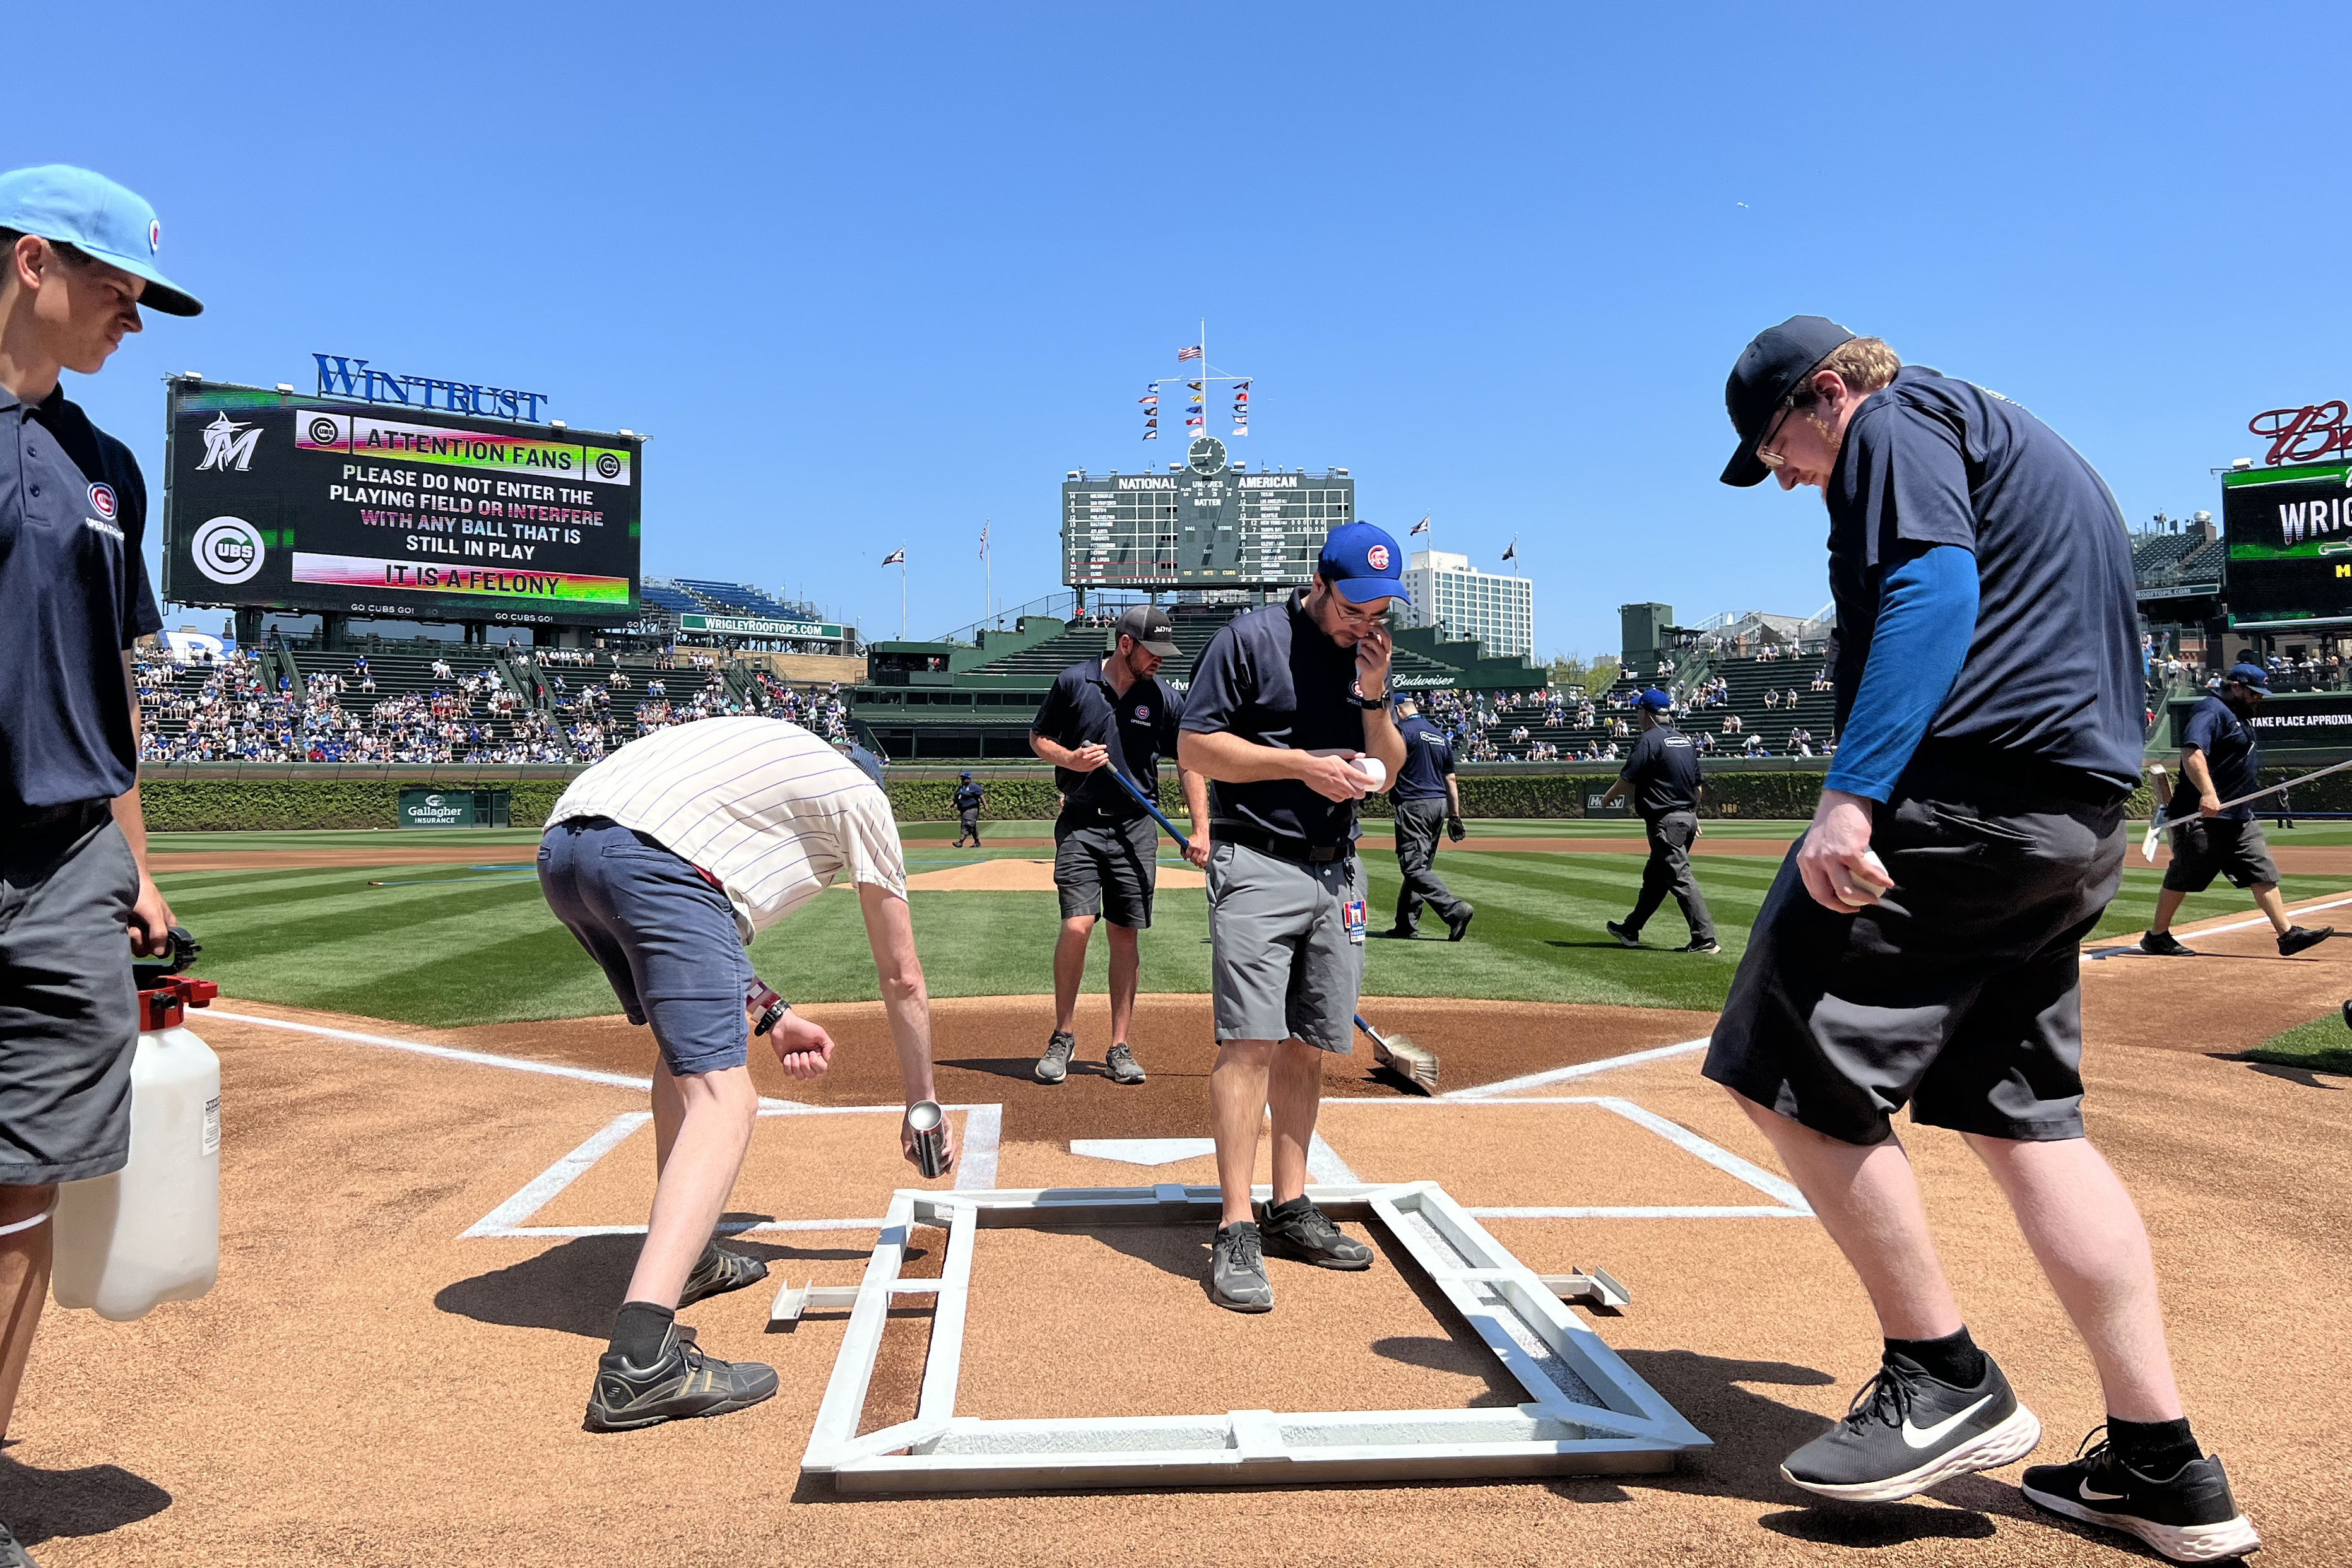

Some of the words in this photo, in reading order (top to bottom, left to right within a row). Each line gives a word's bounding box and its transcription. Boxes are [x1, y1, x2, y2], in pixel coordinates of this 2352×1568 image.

[312, 353, 548, 423] WINTRUST
[2249, 400, 2352, 465] B
[366, 428, 504, 463] ATTENTION
[513, 446, 572, 470] FANS
[343, 464, 417, 487] PLEASE
[422, 473, 448, 490] DO
[454, 476, 492, 494] NOT
[497, 481, 555, 502] ENTER
[559, 488, 593, 505] THE
[1118, 478, 1178, 490] NATIONAL
[1238, 476, 1297, 488] AMERICAN
[330, 485, 415, 508] PLAYING
[420, 493, 473, 514] FIELD
[478, 499, 503, 516] OR
[508, 503, 604, 526] INTERFERE
[360, 509, 412, 529] WITH
[417, 514, 456, 533] ANY
[461, 519, 507, 538] BALL
[512, 523, 560, 542] THAT
[564, 528, 581, 545] IS
[406, 534, 459, 554] STILL
[464, 540, 483, 557] IN
[488, 542, 535, 560] PLAY
[386, 564, 408, 584] IT
[417, 567, 438, 586] IS
[446, 569, 461, 588] A
[470, 571, 560, 594] FELONY
[351, 603, 365, 611] GO
[368, 604, 395, 613] CUBS
[398, 606, 415, 615] GO!
[704, 616, 822, 635] WRIGLEYROOFTOPS.COM
[1392, 673, 1455, 688] Budweiser
[2250, 717, 2274, 728] TAKE
[2275, 716, 2305, 727] PLACE
[408, 806, 463, 818] Gallagher
[1722, 803, 1737, 813] 368
